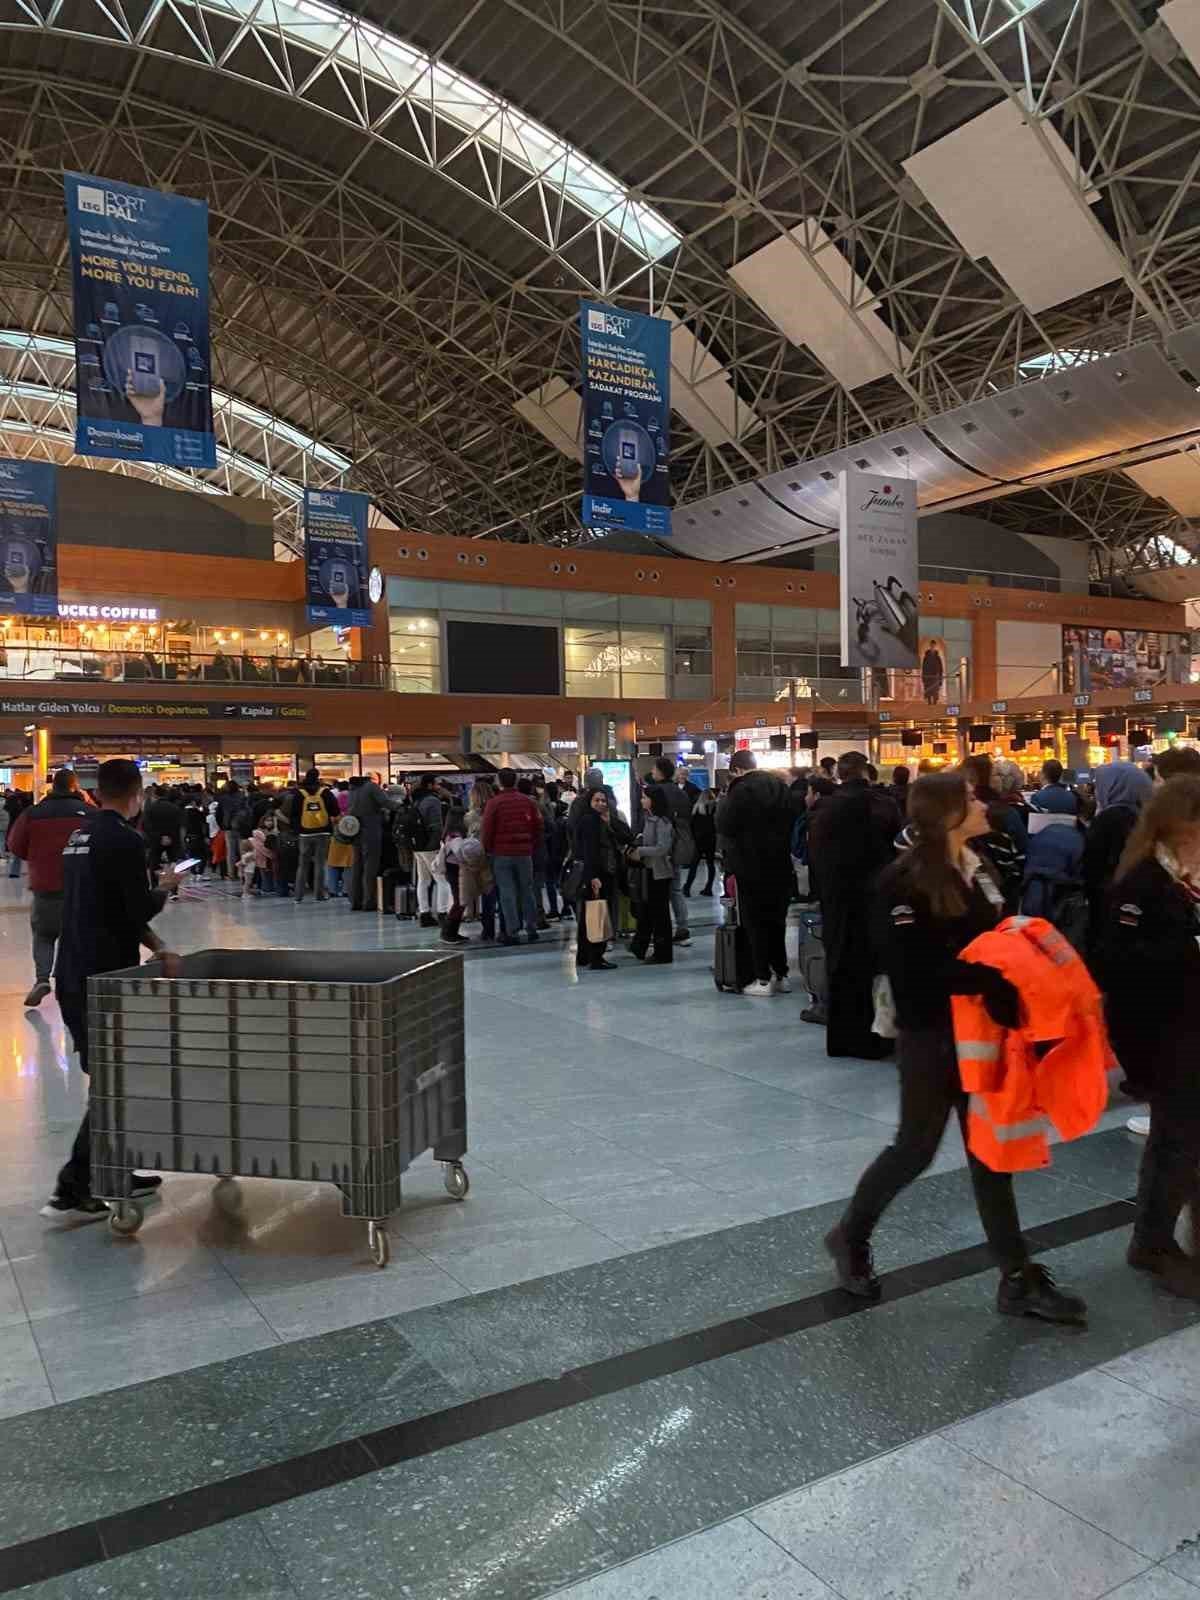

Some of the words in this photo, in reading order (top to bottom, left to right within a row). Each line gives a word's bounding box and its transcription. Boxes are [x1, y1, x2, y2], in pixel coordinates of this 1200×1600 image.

[105, 190, 146, 212] PORT
[105, 204, 137, 222] PAL
[81, 254, 118, 269] MORE
[121, 260, 147, 275] YOU
[150, 264, 193, 285] SPEND,
[81, 267, 122, 283] MORE
[127, 275, 154, 290] YOU
[159, 282, 199, 299] EARN!
[606, 313, 631, 328] PORT
[606, 324, 626, 338] PAL
[588, 355, 656, 380] HARCADIKÇA
[589, 382, 623, 395] SADAKAT
[100, 606, 157, 620] COFFEE
[2, 702, 35, 713] Hatlar
[38, 702, 69, 713] Giden
[72, 703, 100, 713] Yolcu
[108, 704, 153, 715] Domestic
[156, 705, 209, 716] Departures
[281, 708, 306, 717] Gates
